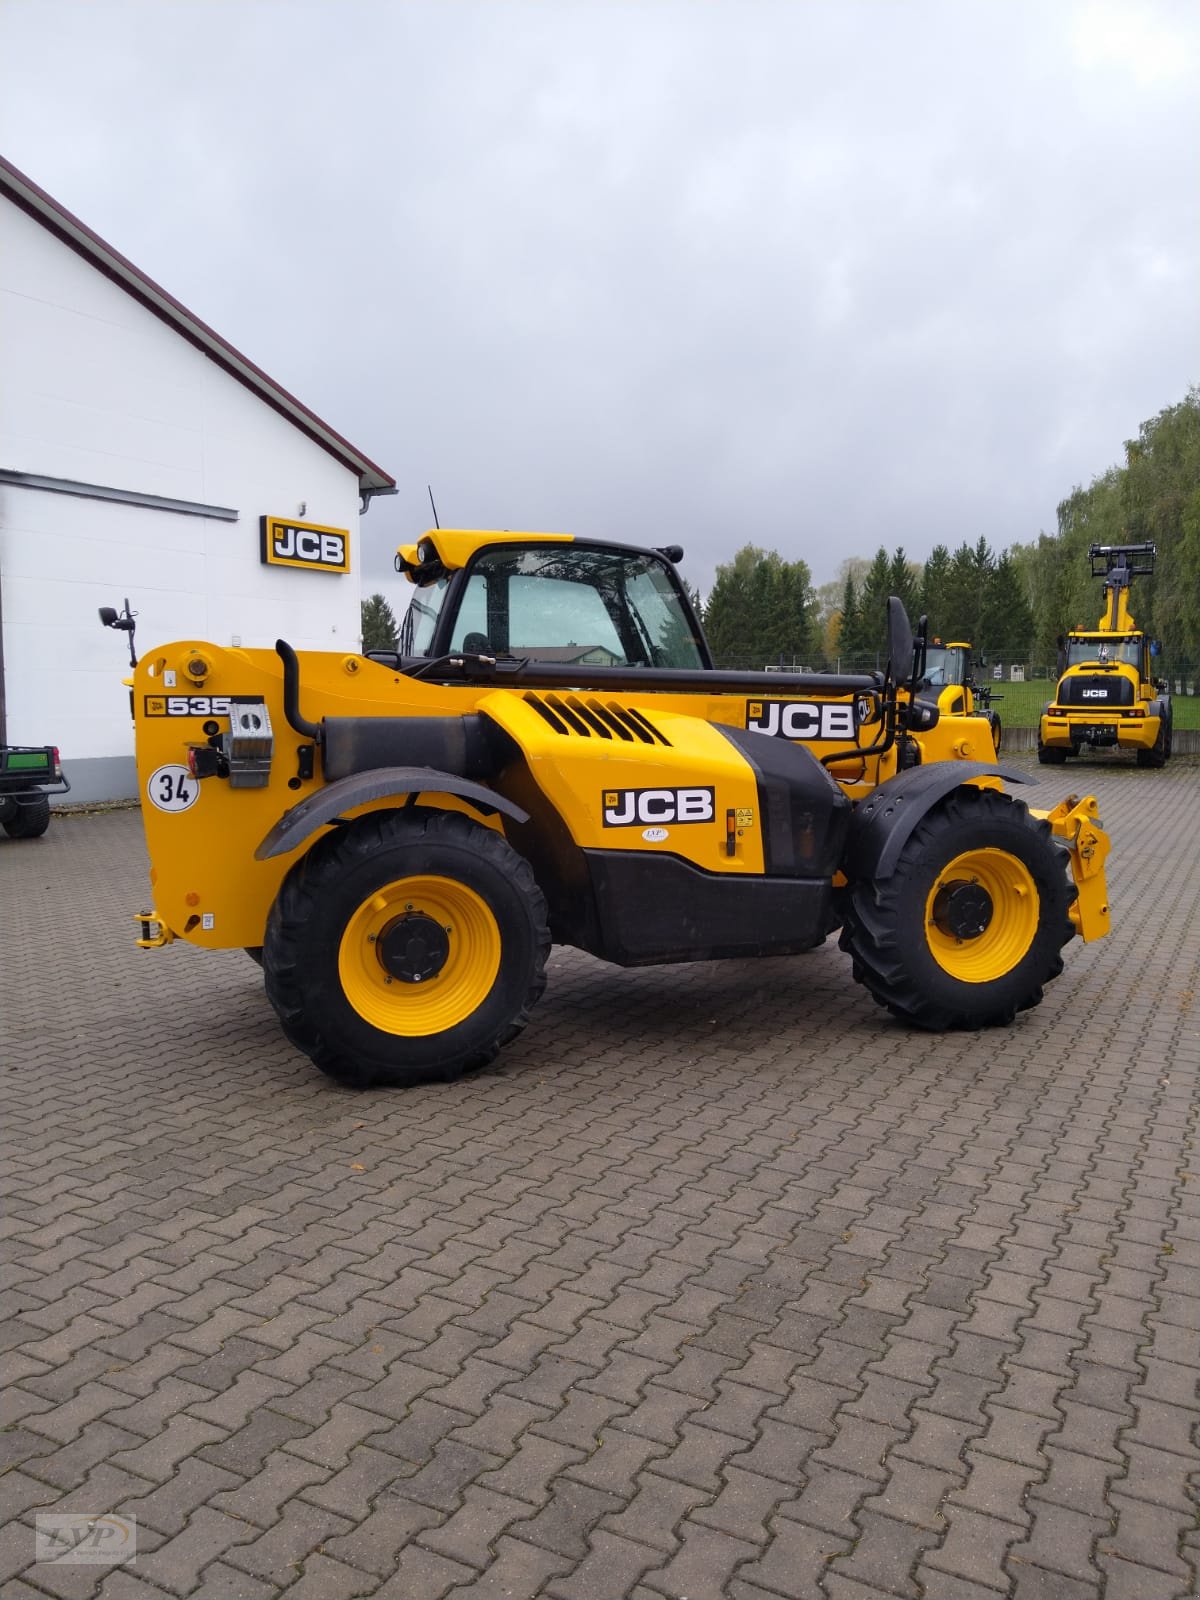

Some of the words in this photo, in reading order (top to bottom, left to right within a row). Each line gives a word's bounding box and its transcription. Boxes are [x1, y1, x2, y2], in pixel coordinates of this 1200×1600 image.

[274, 528, 344, 564] JCB
[167, 697, 232, 716] 535
[1082, 689, 1108, 698] JCB
[748, 703, 855, 738] JCB
[159, 774, 190, 803] 34
[605, 788, 713, 825] JCB
